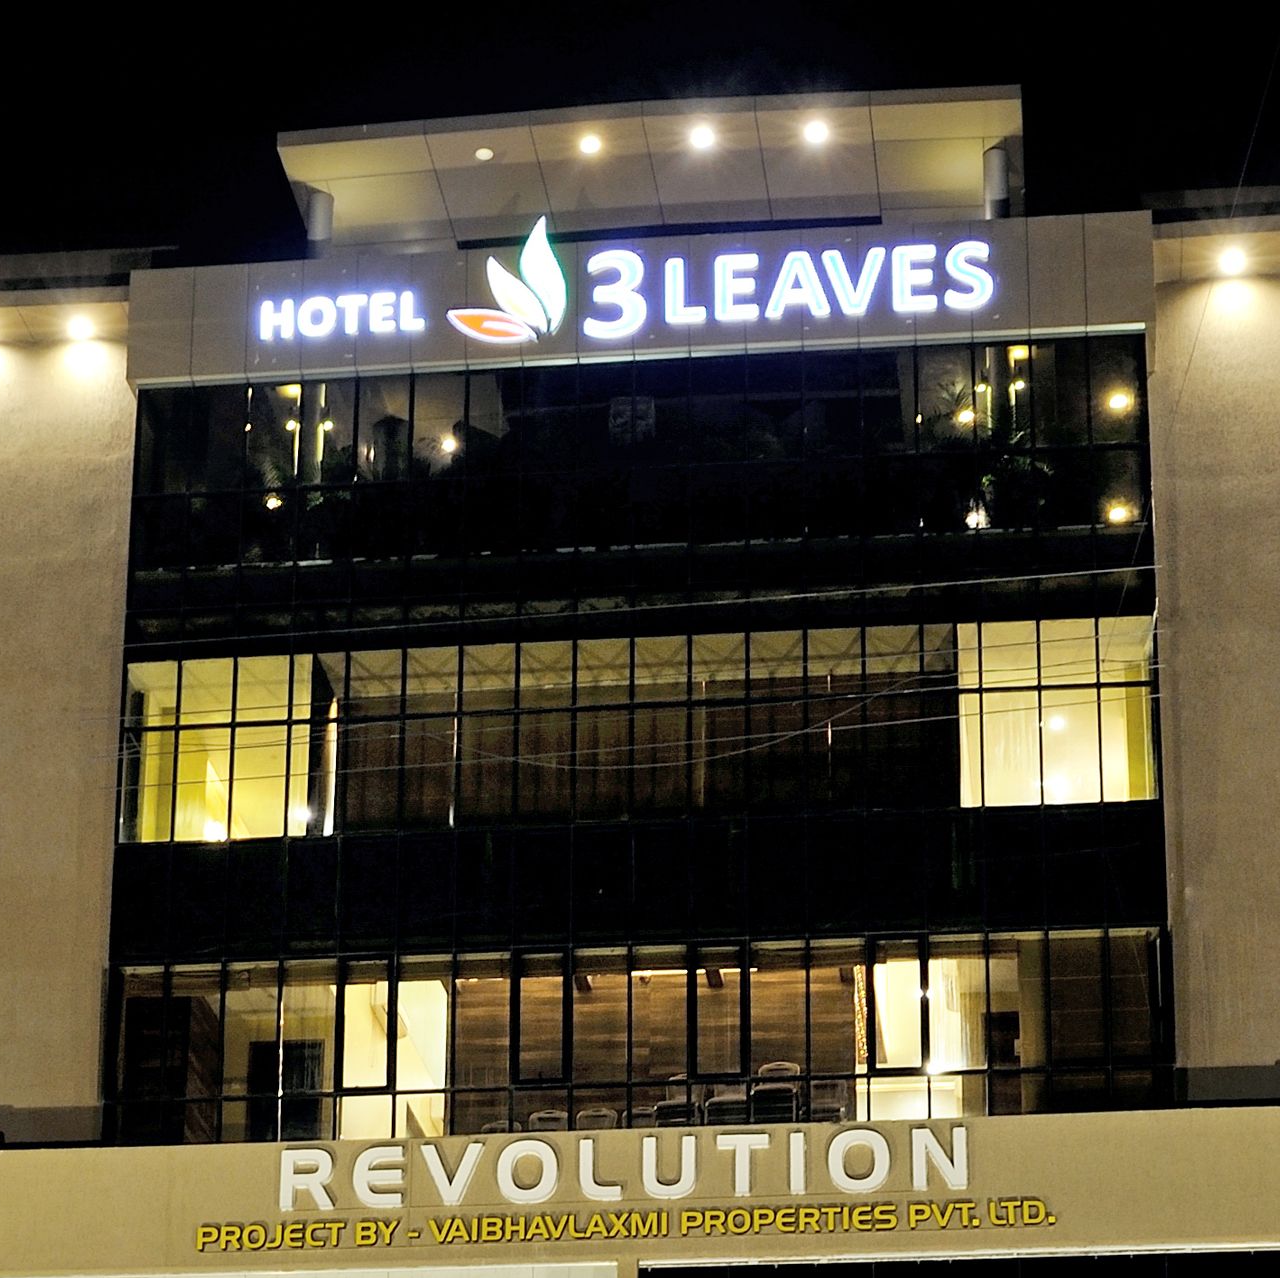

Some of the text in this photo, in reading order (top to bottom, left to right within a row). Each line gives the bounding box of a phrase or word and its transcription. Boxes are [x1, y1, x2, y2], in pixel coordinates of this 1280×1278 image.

[259, 240, 995, 341] HOTEL 3 LEAVES
[278, 1126, 969, 1212] REVOLUTION
[197, 1222, 345, 1251] PROJECT
[355, 1220, 398, 1246] BY
[429, 1212, 670, 1244] VAIBHAVLAXMI
[681, 1204, 898, 1236] PROPERTIES
[910, 1202, 980, 1230] PVT.
[990, 1200, 1056, 1226] LTD.
